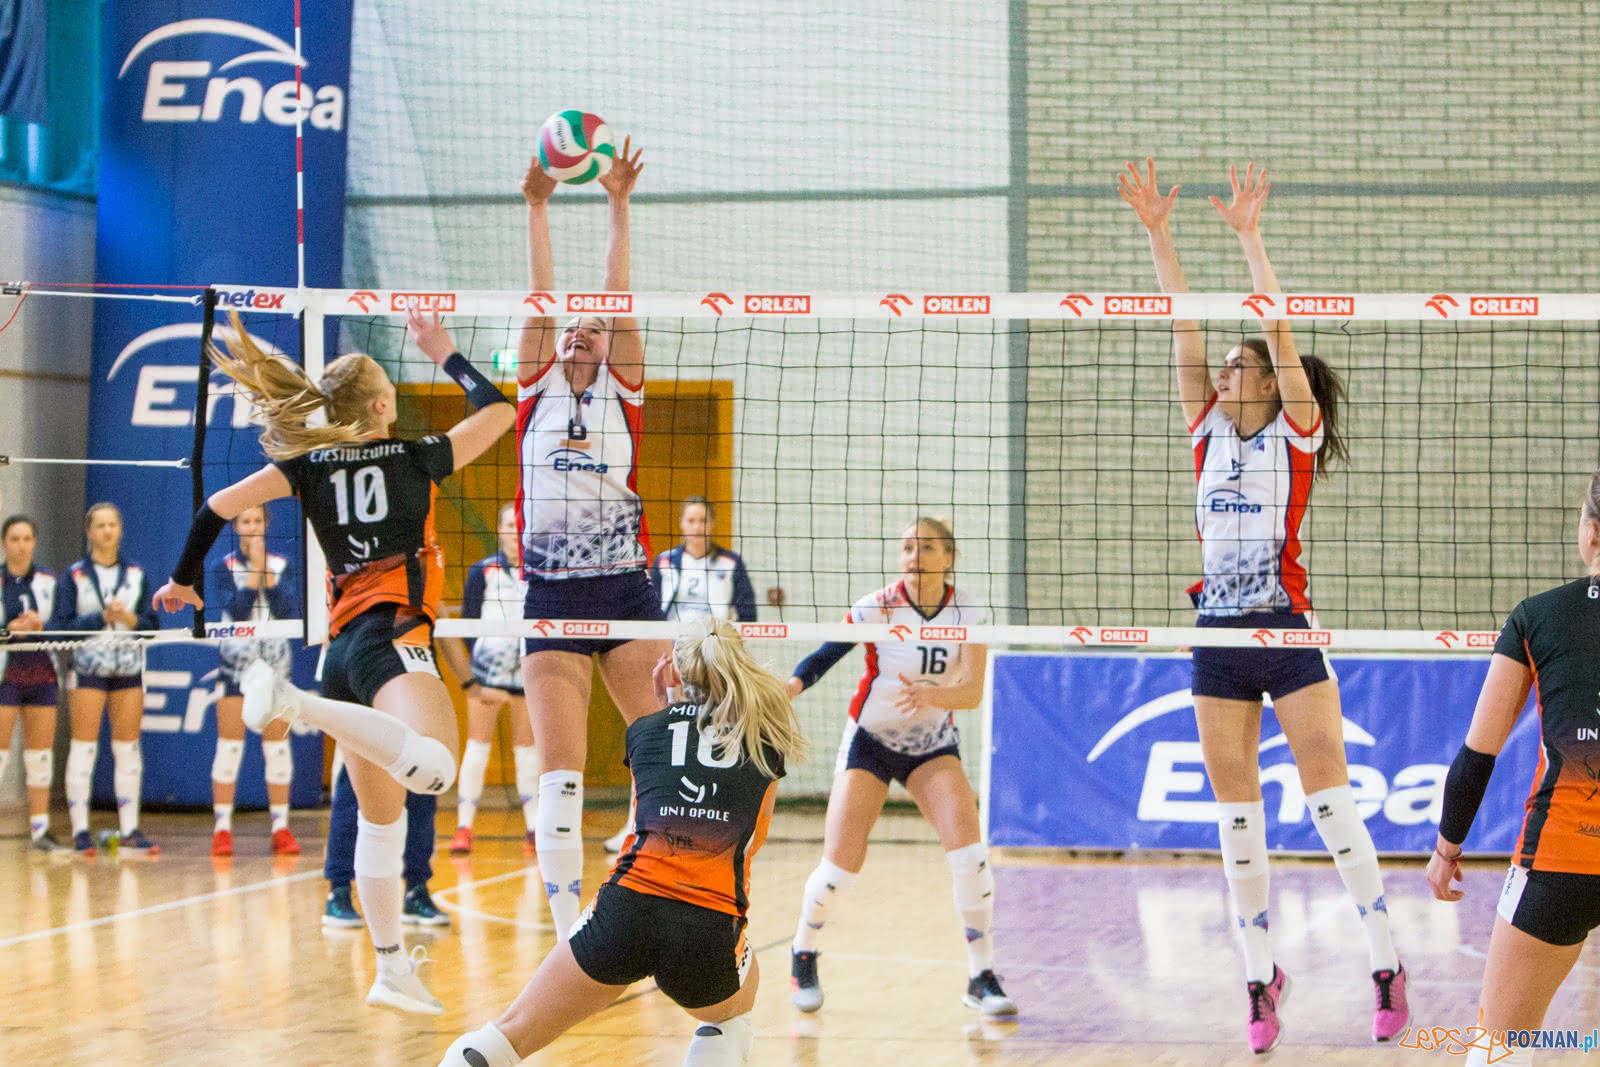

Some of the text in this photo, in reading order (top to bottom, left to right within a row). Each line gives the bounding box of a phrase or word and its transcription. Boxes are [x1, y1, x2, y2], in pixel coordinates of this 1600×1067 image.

[142, 61, 344, 132] Enea
[215, 289, 286, 309] netex
[569, 296, 631, 311] ORLEN
[747, 297, 809, 312] ORLEN
[926, 297, 988, 312] ORLEN
[1106, 298, 1169, 313] ORLEN
[1289, 298, 1351, 314] ORLEN
[1472, 298, 1536, 314] ORLEN
[553, 458, 608, 474] Enea
[329, 465, 389, 525] 10
[1211, 498, 1262, 513] Enea
[208, 624, 256, 638] netex
[564, 624, 608, 635] ORLEN
[743, 625, 785, 637] ORLEN
[921, 628, 965, 639] ORLEN
[1102, 630, 1147, 641] ORLEN
[1284, 632, 1330, 644] ORLEN
[1468, 635, 1497, 646] ORL
[916, 645, 948, 675] 16
[1137, 741, 1449, 825] Enea
[659, 806, 730, 822] UNI OPOLE
